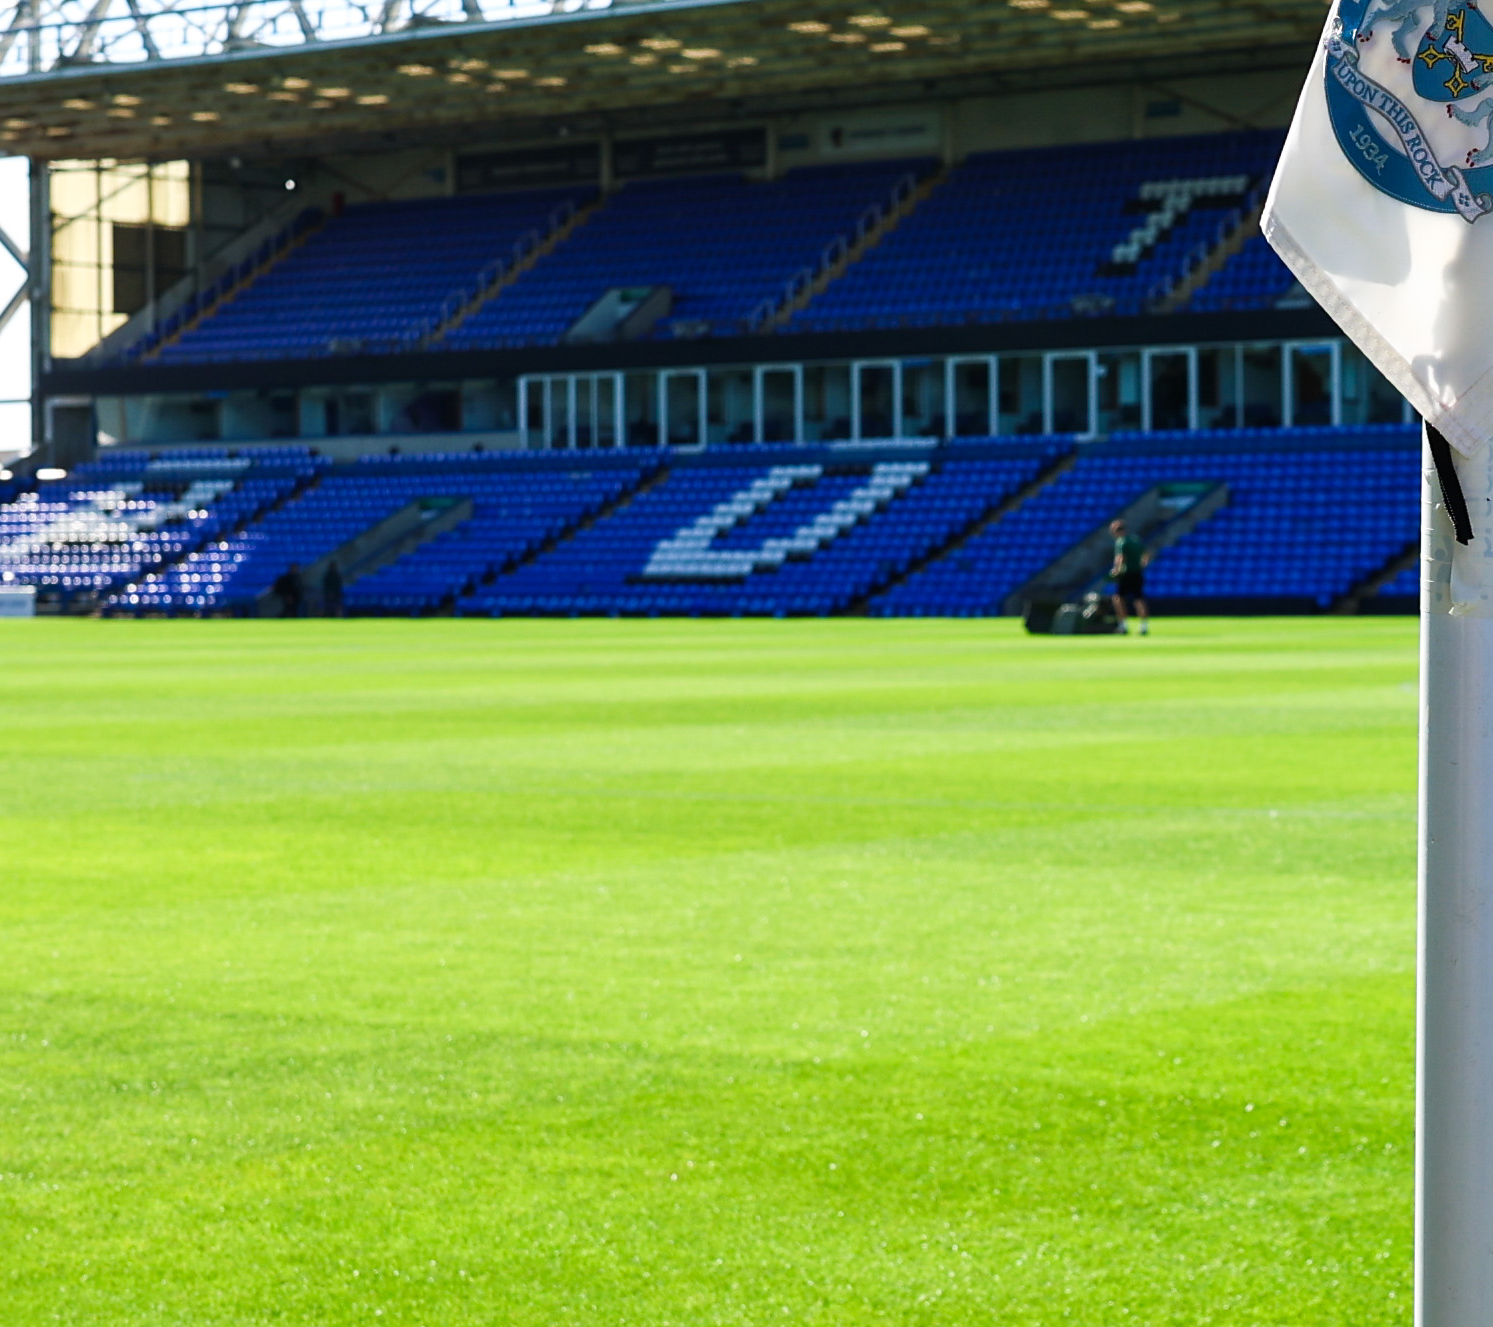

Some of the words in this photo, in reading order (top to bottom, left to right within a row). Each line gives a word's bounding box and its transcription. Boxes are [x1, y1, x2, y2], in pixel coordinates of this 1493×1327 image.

[1338, 62, 1377, 103] UPON
[1378, 95, 1416, 134] THIS
[1406, 133, 1444, 190] ROCK
[1349, 124, 1389, 176] 1934
